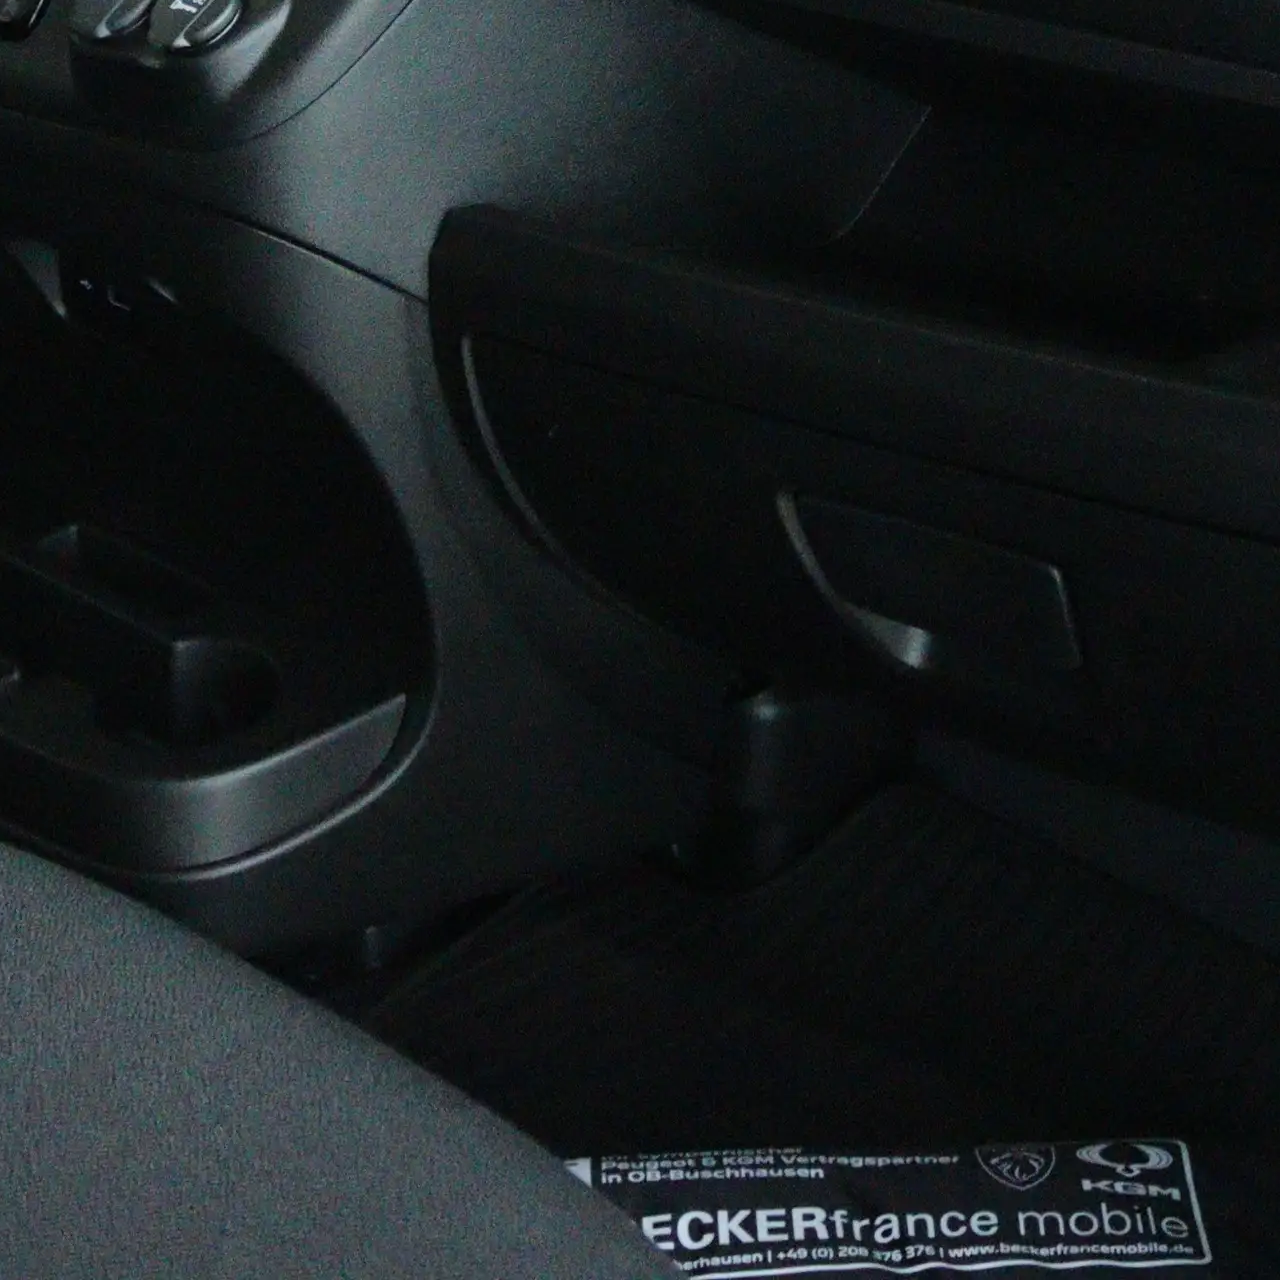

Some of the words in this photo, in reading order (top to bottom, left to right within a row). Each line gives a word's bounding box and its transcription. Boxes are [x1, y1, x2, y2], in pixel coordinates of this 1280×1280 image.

[601, 1158, 696, 1172] Peugeot
[780, 1153, 961, 1169] Vertragspartner
[600, 1172, 622, 1185] in
[627, 1167, 825, 1183] OB-Buschhausen
[1081, 1178, 1182, 1202] KGM
[642, 1206, 1000, 1251] ECKERfrance
[1017, 1201, 1190, 1239] mobile
[677, 1252, 764, 1271] erhausen
[776, 1247, 808, 1261] +49
[811, 1246, 834, 1261] (0)
